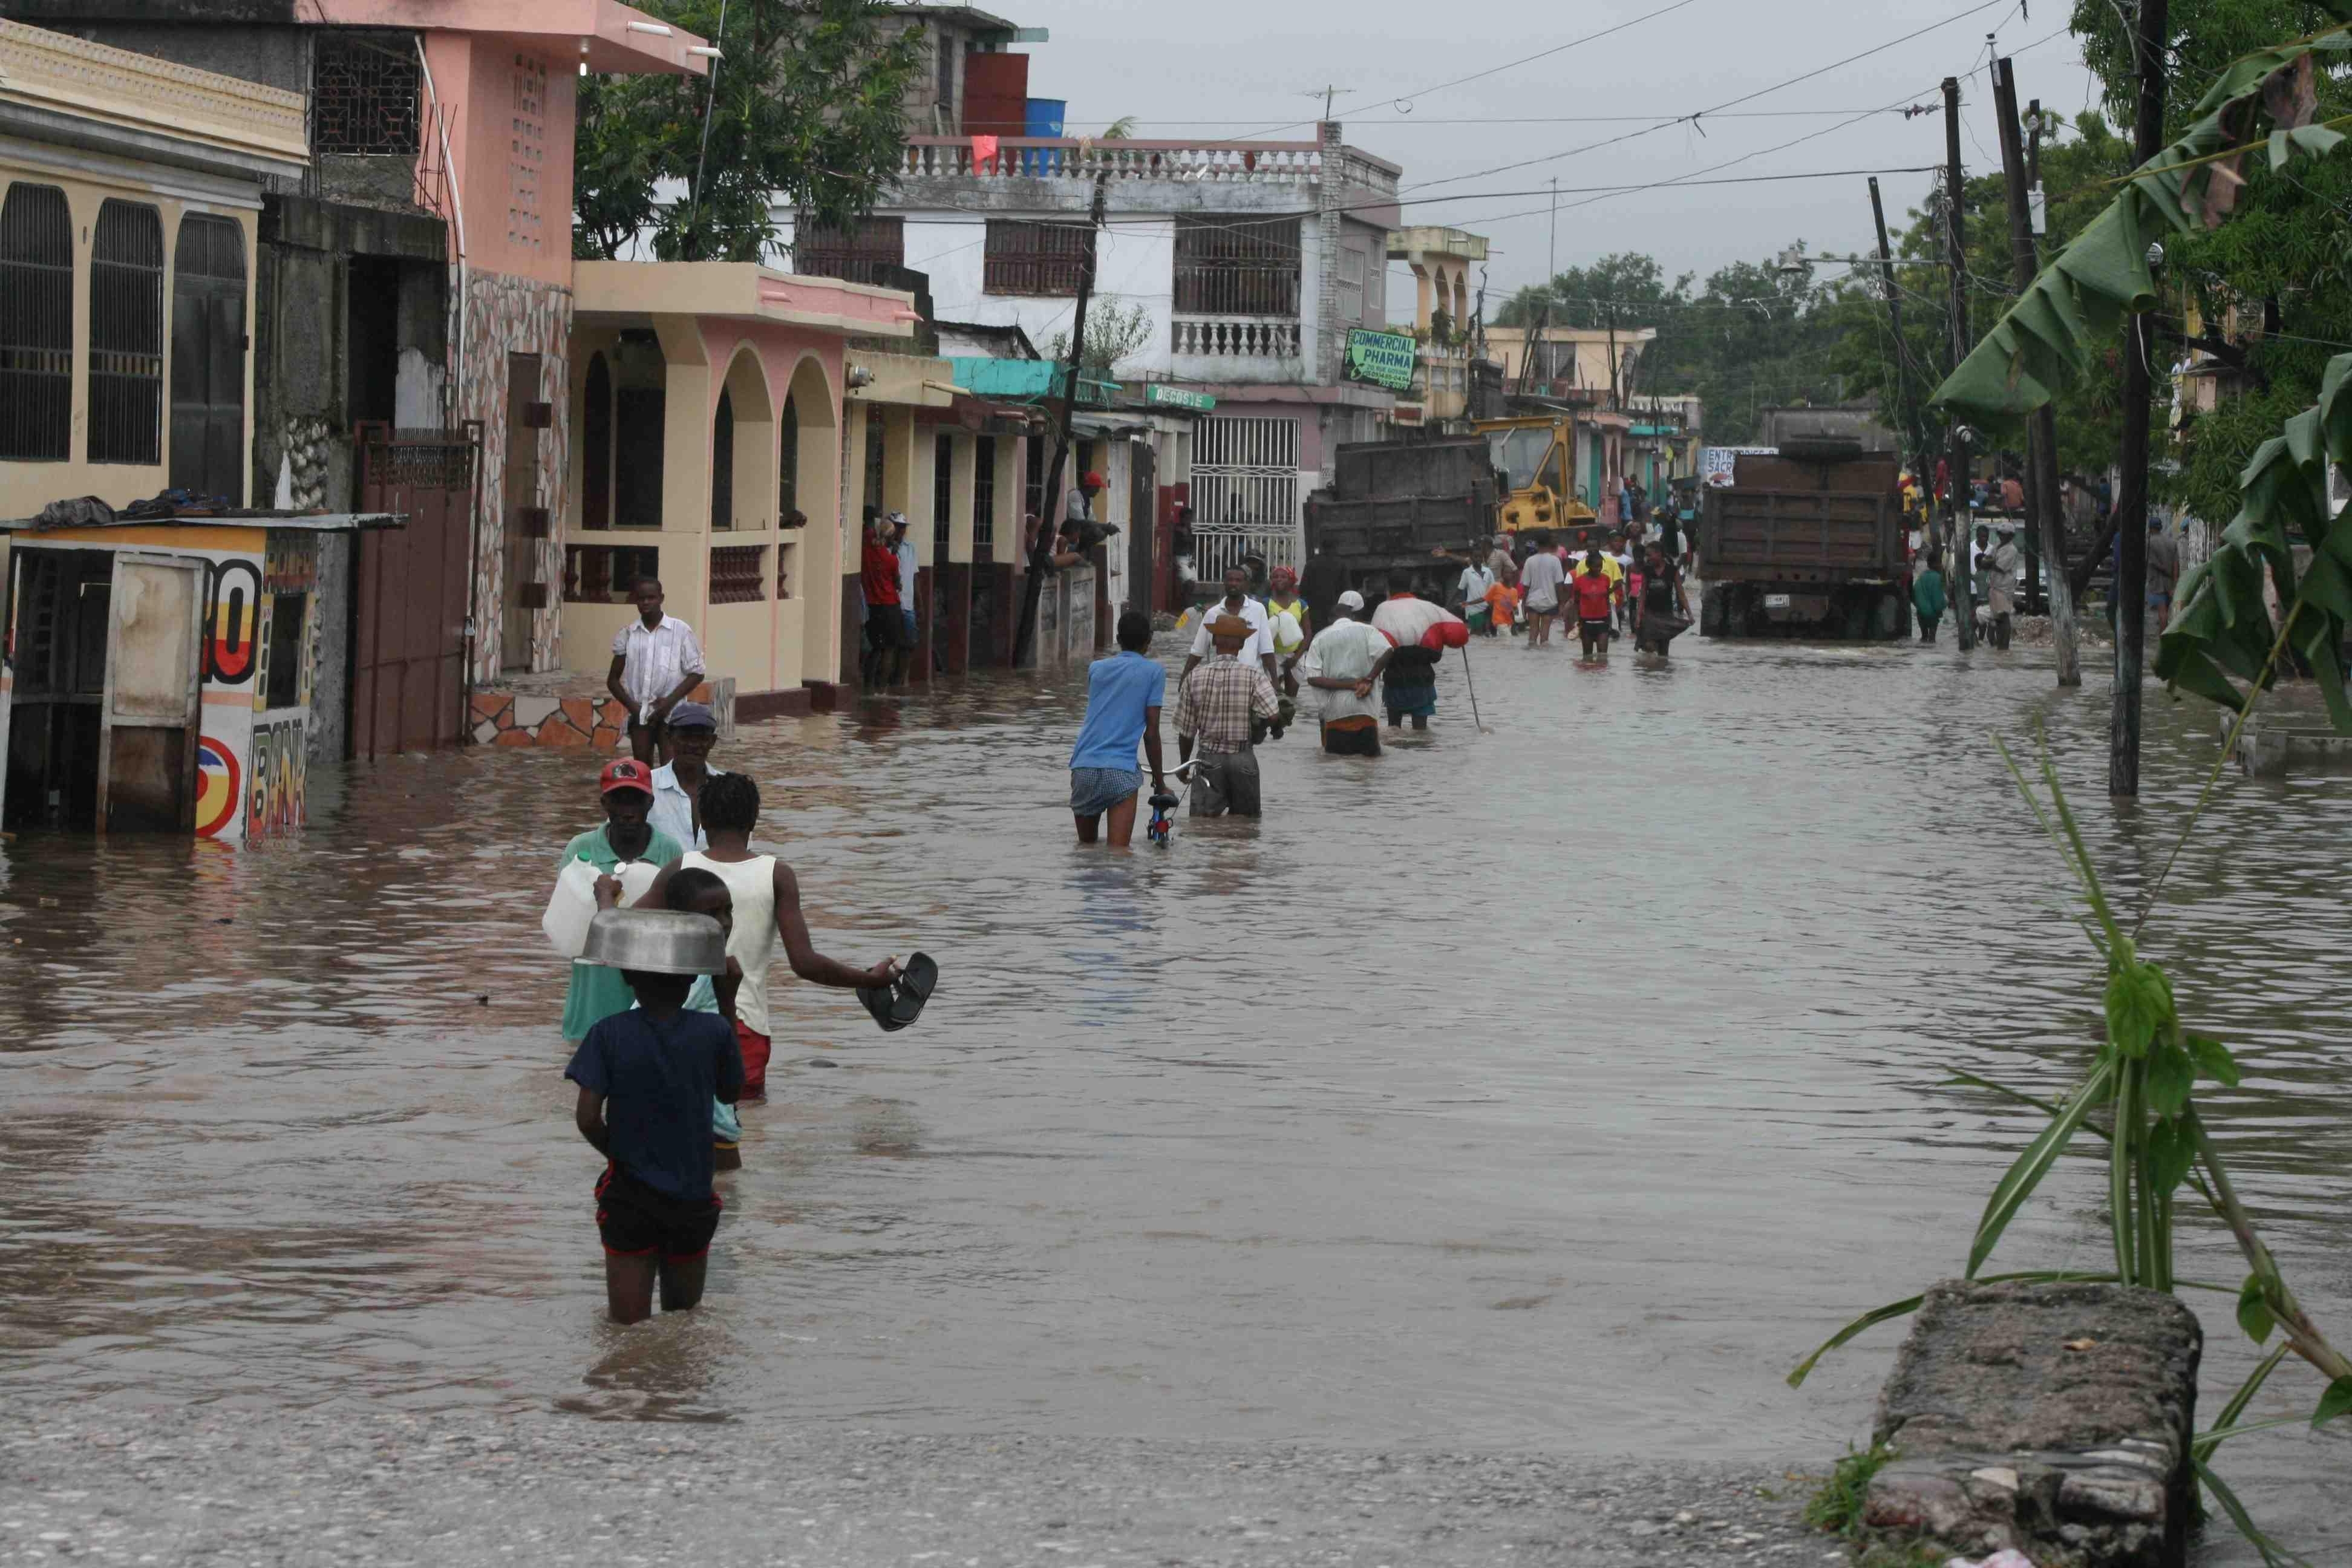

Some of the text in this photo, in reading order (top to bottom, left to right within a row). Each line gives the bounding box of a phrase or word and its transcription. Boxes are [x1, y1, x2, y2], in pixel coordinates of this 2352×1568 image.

[1353, 331, 1413, 353] COMMERCIAL
[1364, 349, 1411, 368] PHARMA
[247, 719, 307, 846] BANK
